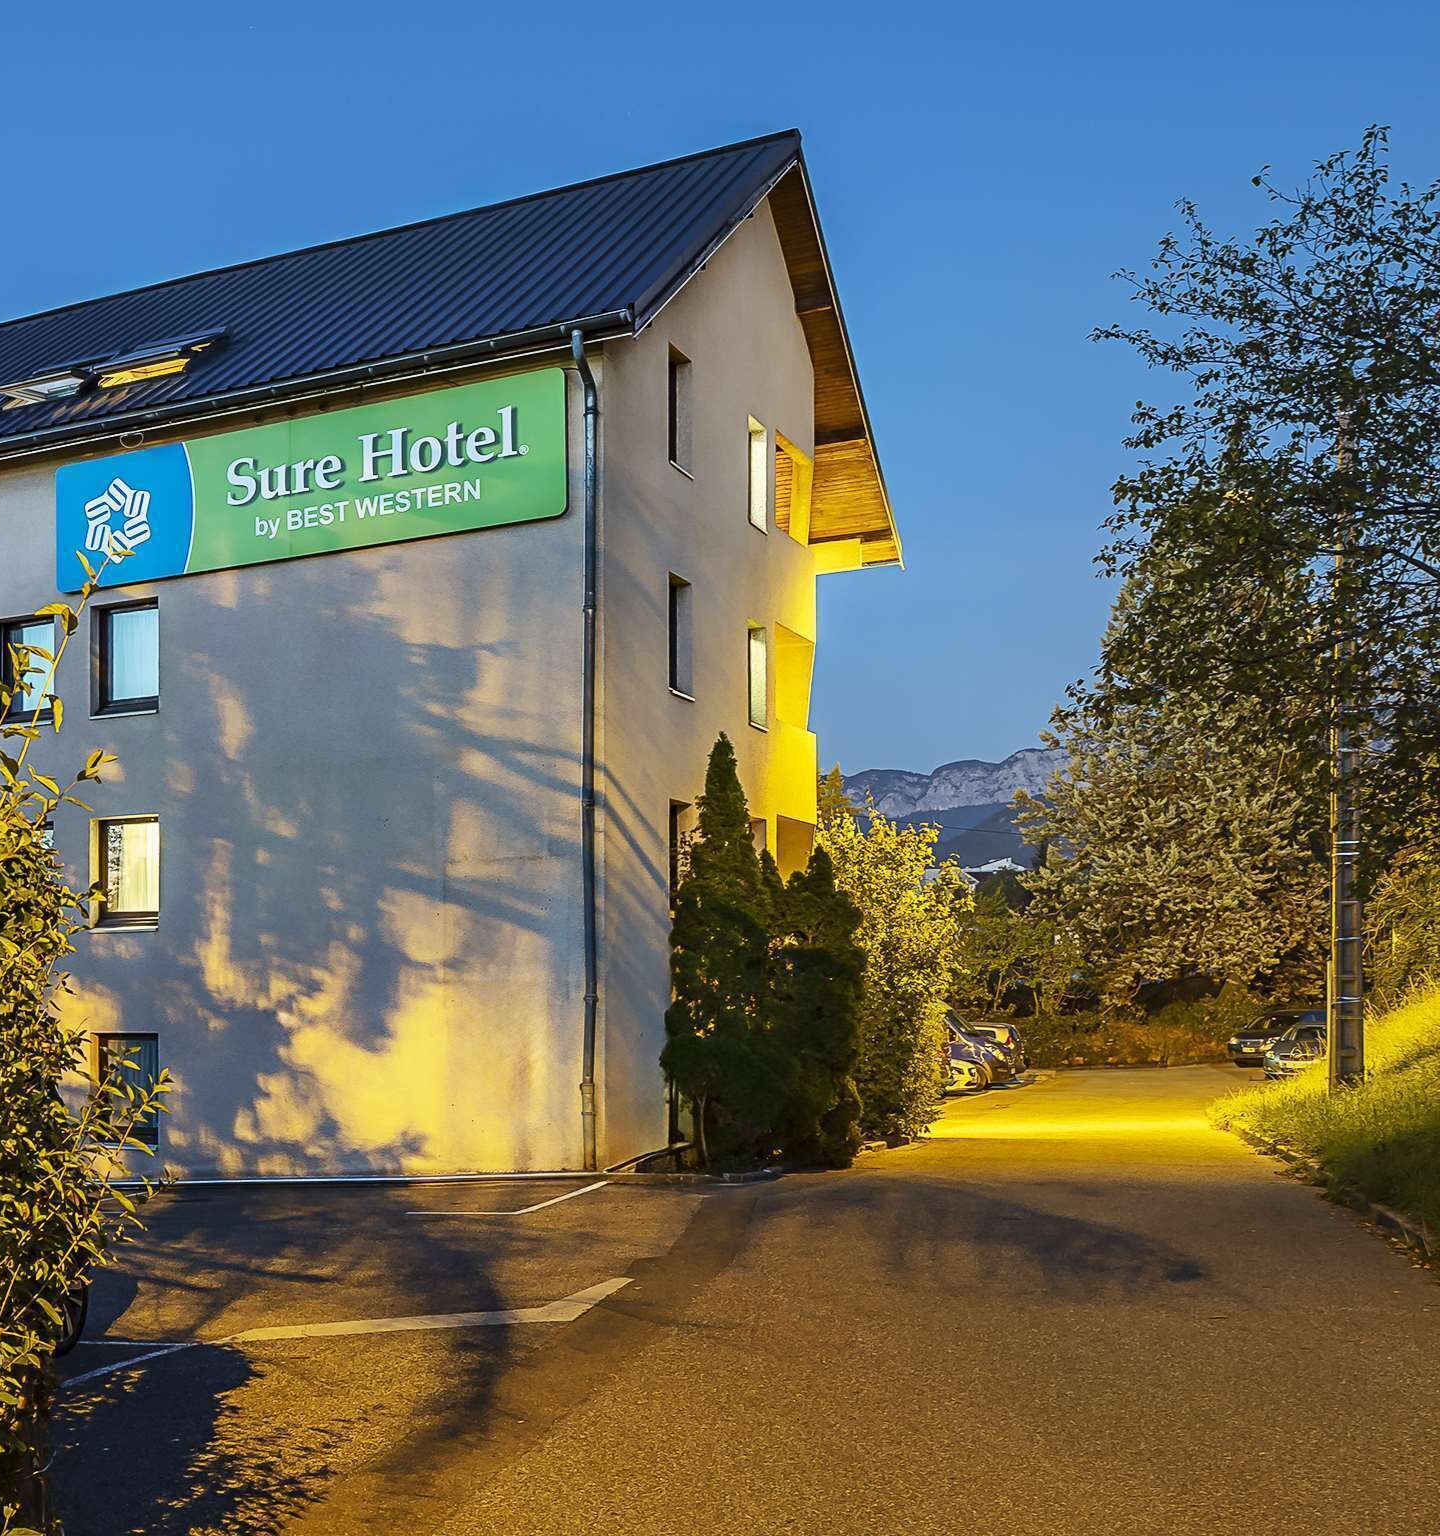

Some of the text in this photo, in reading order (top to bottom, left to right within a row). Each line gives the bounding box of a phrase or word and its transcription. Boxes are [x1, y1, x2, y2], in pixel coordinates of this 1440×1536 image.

[226, 455, 344, 507] Sure
[255, 478, 482, 541] by BEST WESTERN
